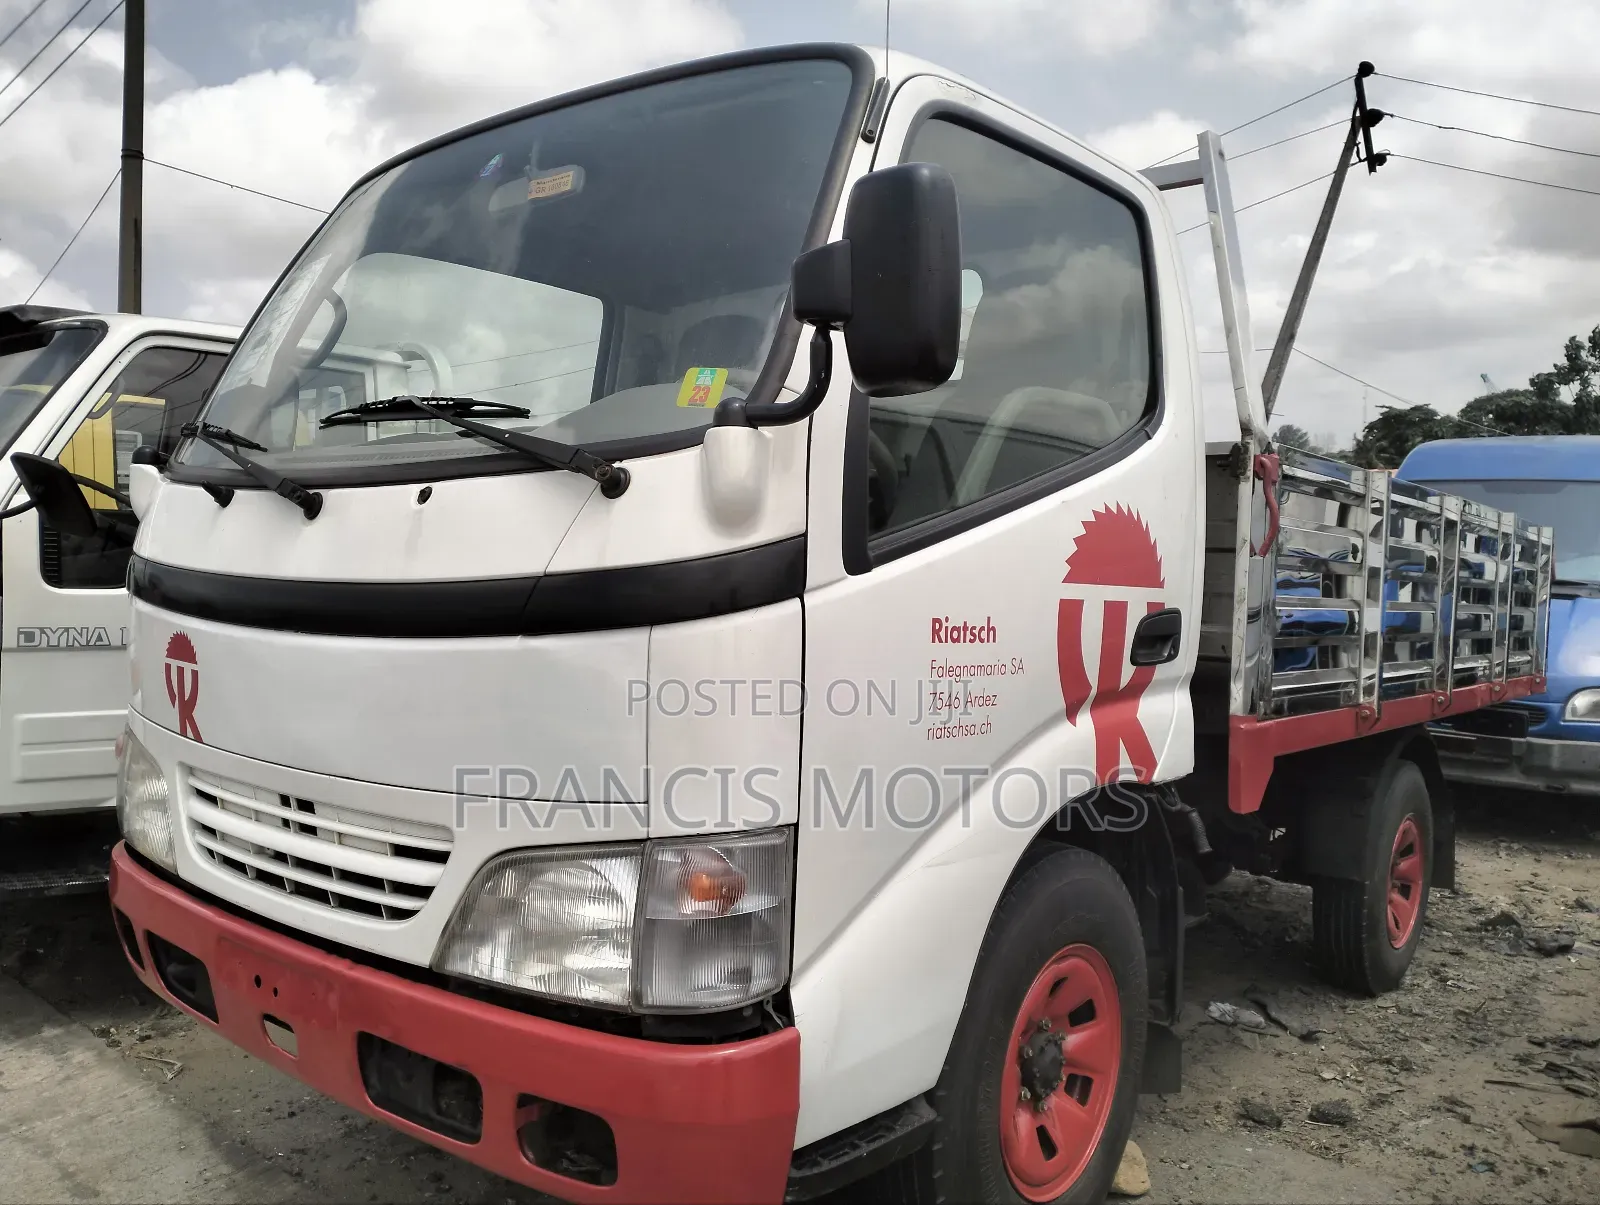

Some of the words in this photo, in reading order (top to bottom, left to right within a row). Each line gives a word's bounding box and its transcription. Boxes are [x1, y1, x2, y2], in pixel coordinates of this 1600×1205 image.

[688, 385, 711, 403] 23
[17, 626, 111, 648] DYNA
[931, 616, 997, 644] Riatsch
[930, 657, 1007, 683] Falegnamaria
[1010, 657, 1025, 675] SA
[928, 690, 961, 711] 7546
[964, 687, 998, 709] Ardez
[927, 714, 992, 741] riatschsa.ch
